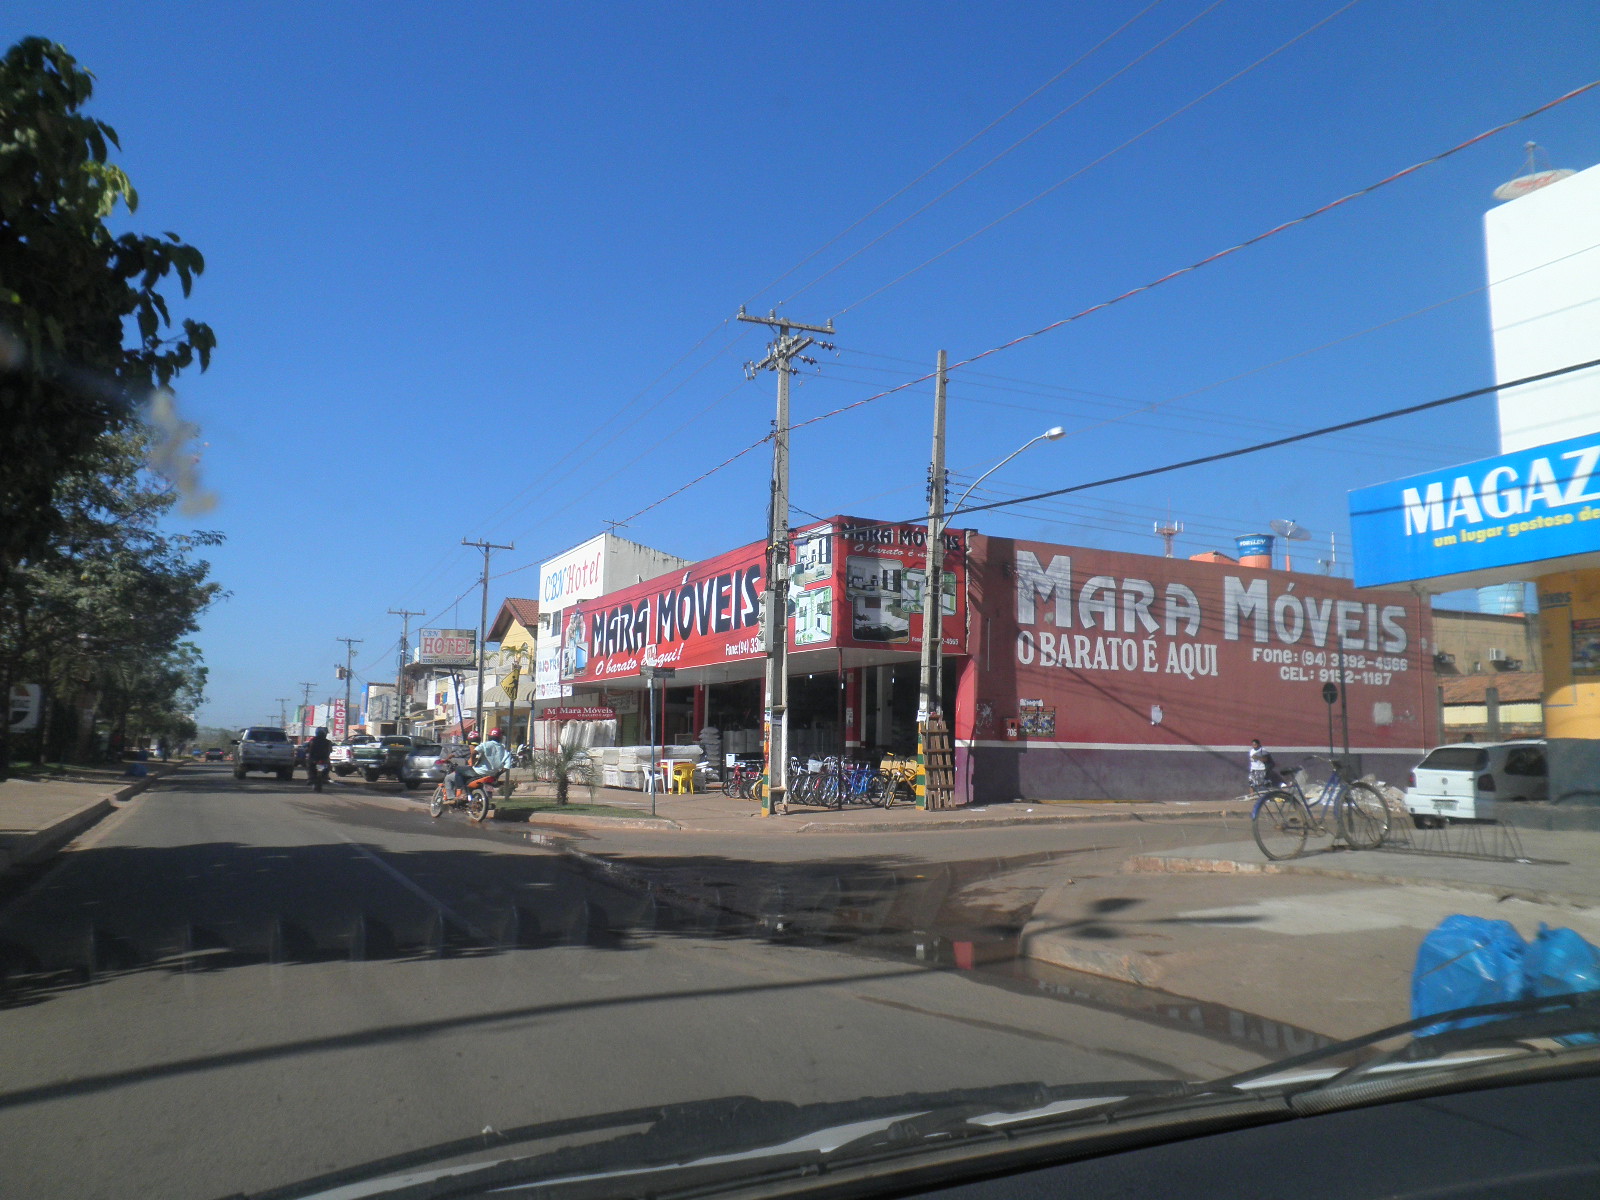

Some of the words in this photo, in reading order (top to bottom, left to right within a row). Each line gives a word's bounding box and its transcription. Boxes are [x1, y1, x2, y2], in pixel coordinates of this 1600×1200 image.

[1402, 445, 1600, 536] MAGAZ
[898, 528, 960, 551] MÓIS
[1434, 535, 1457, 547] um
[1460, 527, 1504, 543] lugar
[1508, 514, 1574, 537] gostoso
[545, 568, 567, 602] CBN
[566, 552, 601, 595] Hotel
[591, 598, 650, 660] MARA
[656, 564, 761, 645] MÓVEIS
[1017, 550, 1201, 637] MARA
[1224, 576, 1407, 653] MÓVEIS
[422, 637, 473, 655] HOTEL
[1018, 631, 1035, 665] O
[1039, 632, 1138, 671] BARATO
[1143, 635, 1158, 673] É
[1165, 641, 1218, 680] AQUI
[1252, 647, 1298, 663] Fone:
[1302, 650, 1327, 667] (94)
[605, 657, 637, 674] barato
[1280, 666, 1315, 681] CEL:
